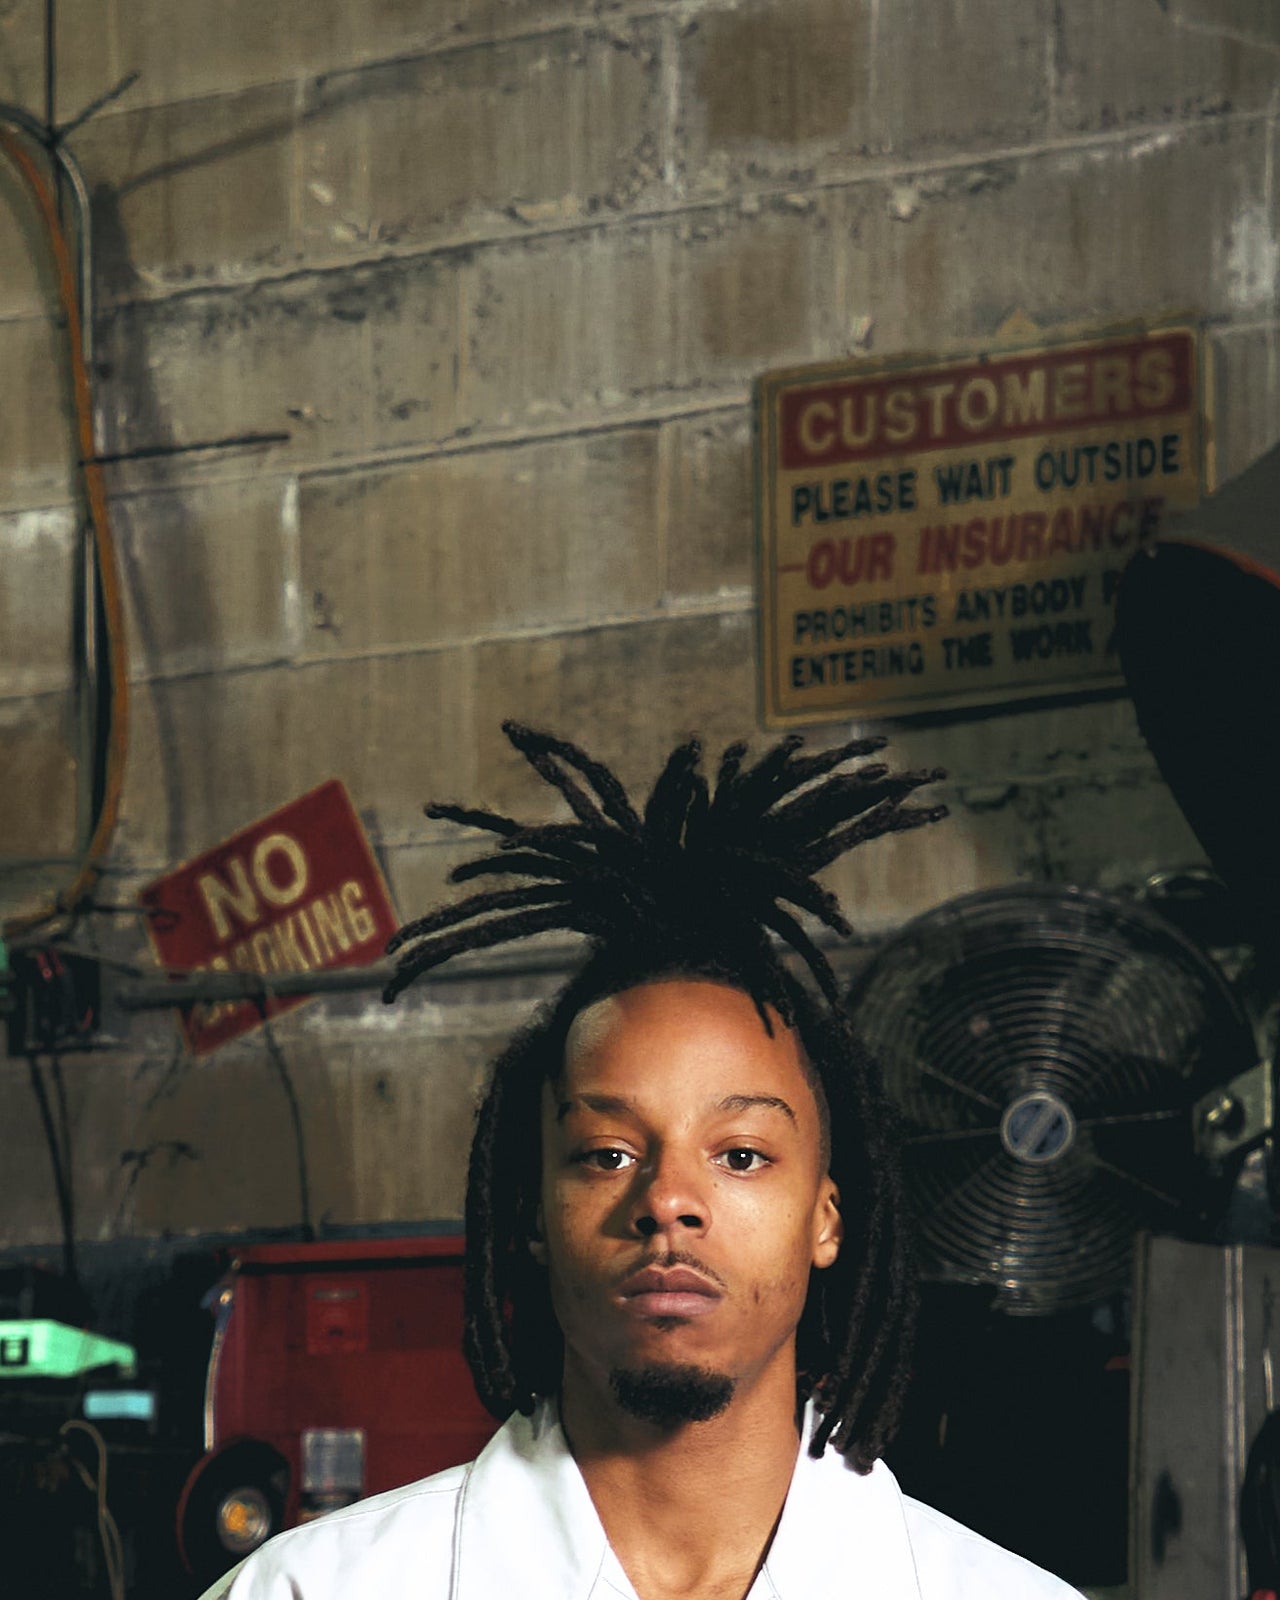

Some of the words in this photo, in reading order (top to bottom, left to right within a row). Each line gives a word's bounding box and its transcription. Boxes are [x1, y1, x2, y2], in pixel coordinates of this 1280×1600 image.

[799, 347, 1177, 456] CUSTOMERS
[791, 470, 917, 527] PLEASE
[934, 456, 1014, 505] WAIT
[1034, 433, 1180, 491] OUTSIDE
[806, 530, 897, 590] OUR
[917, 495, 1165, 576] INSURANCE
[790, 643, 926, 690] ENTERING
[941, 631, 994, 671] THE
[1010, 618, 1094, 664] WORK
[794, 594, 938, 645] PROHIBITS
[955, 572, 1086, 623] ANYBODY
[197, 832, 310, 942] NO
